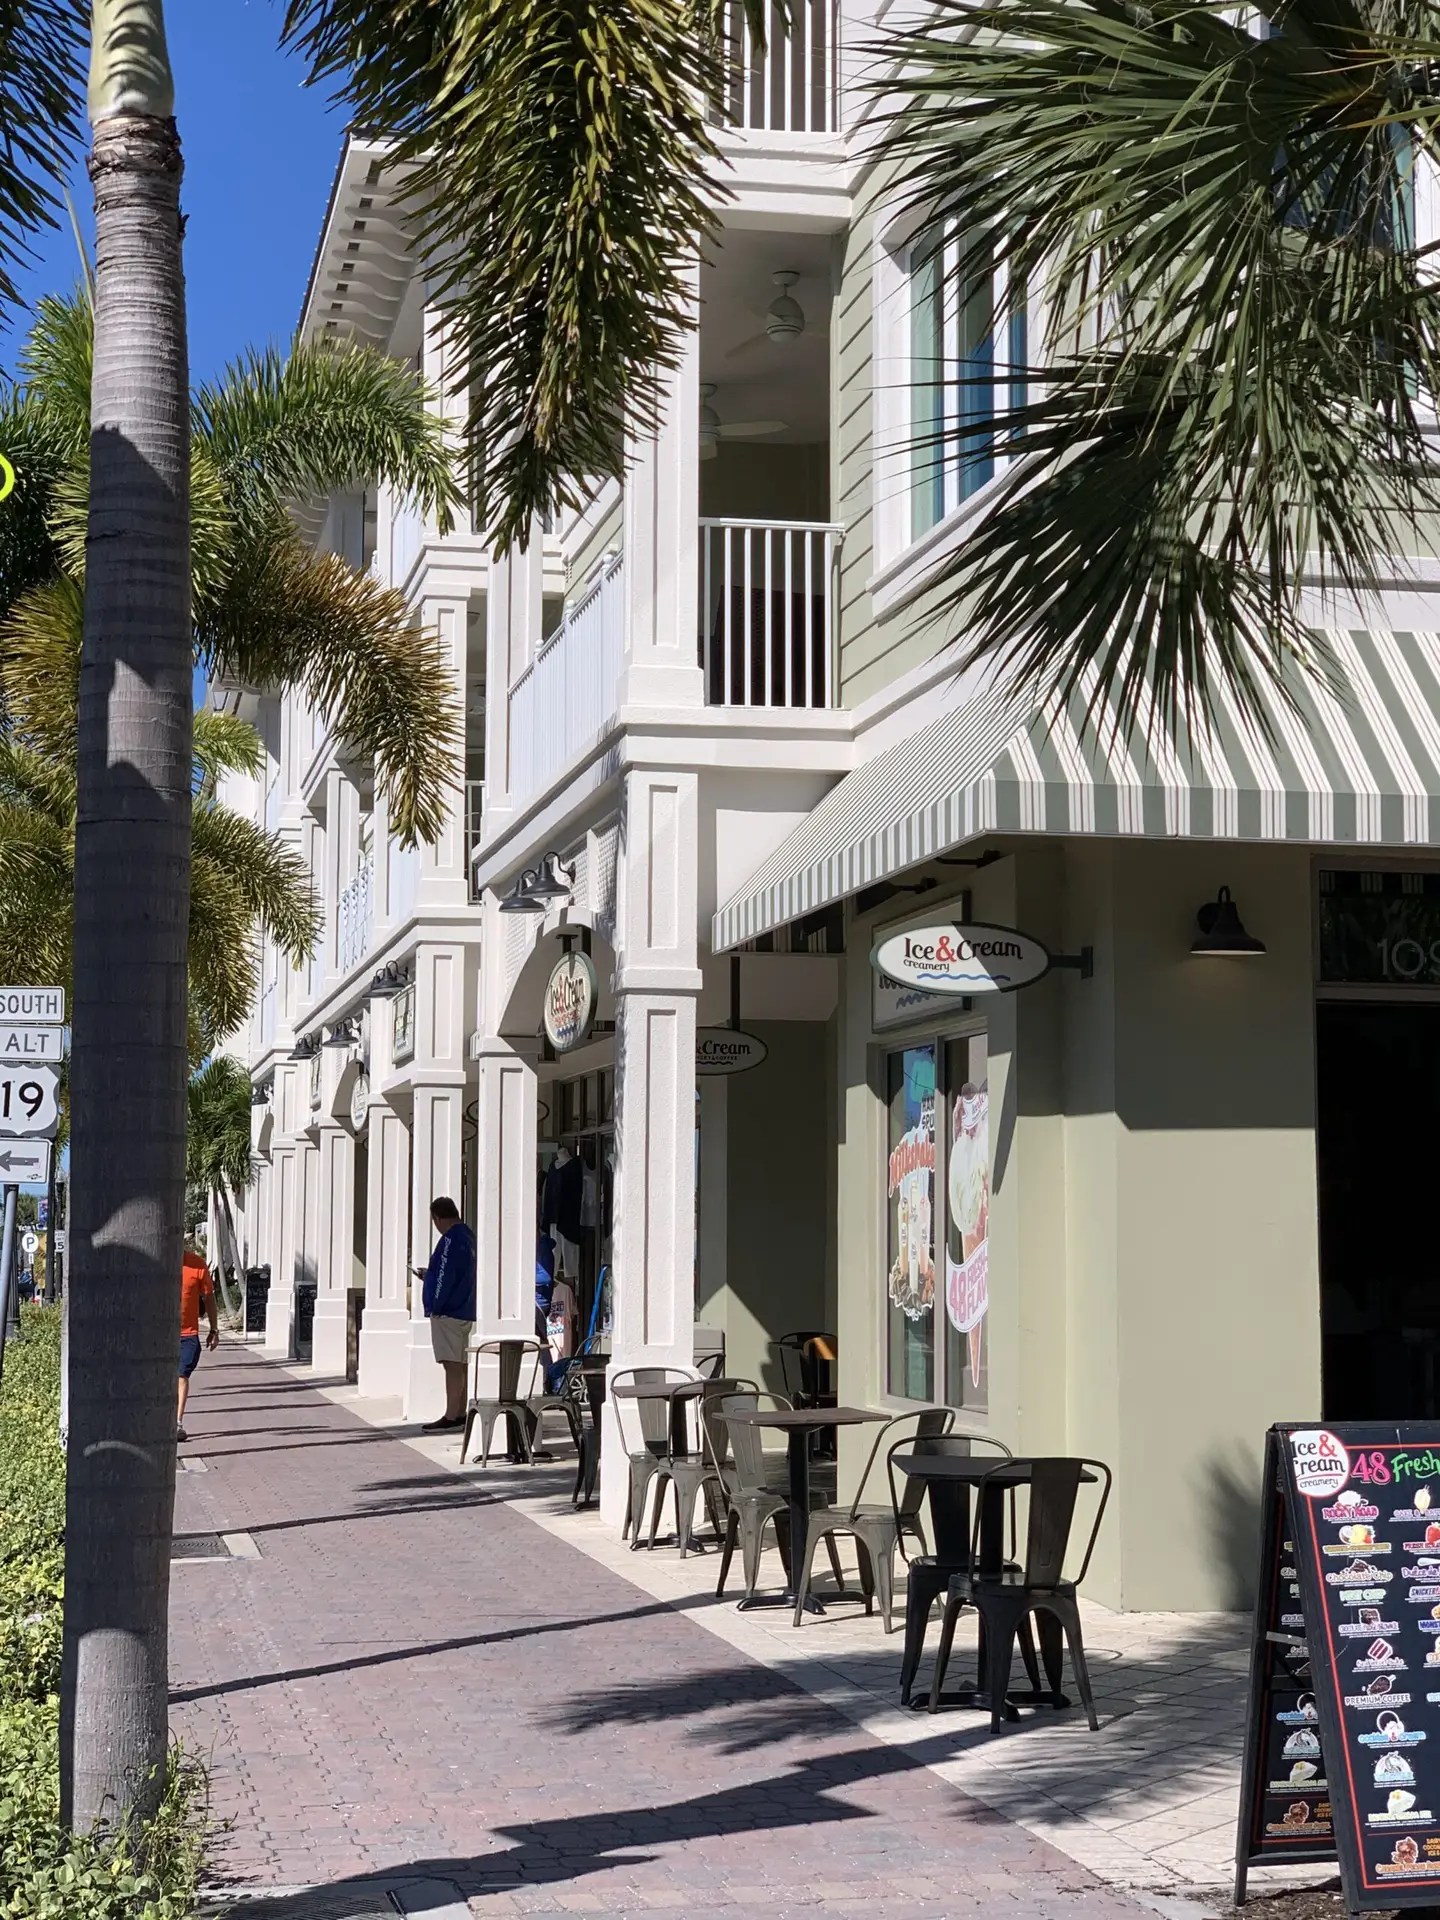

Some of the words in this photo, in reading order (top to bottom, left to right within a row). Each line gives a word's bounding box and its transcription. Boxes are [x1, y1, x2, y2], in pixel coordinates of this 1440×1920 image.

[903, 959, 950, 972] creamery
[5, 1033, 49, 1053] ALT
[2, 1081, 44, 1118] 19
[26, 1237, 35, 1249] P
[949, 1268, 967, 1323] 48
[1351, 1451, 1391, 1486] 48
[1391, 1449, 1440, 1482] Fresh
[1300, 1479, 1338, 1488] creamery
[1344, 1694, 1381, 1706] PREMIUM
[1382, 1692, 1410, 1703] COFFEE
